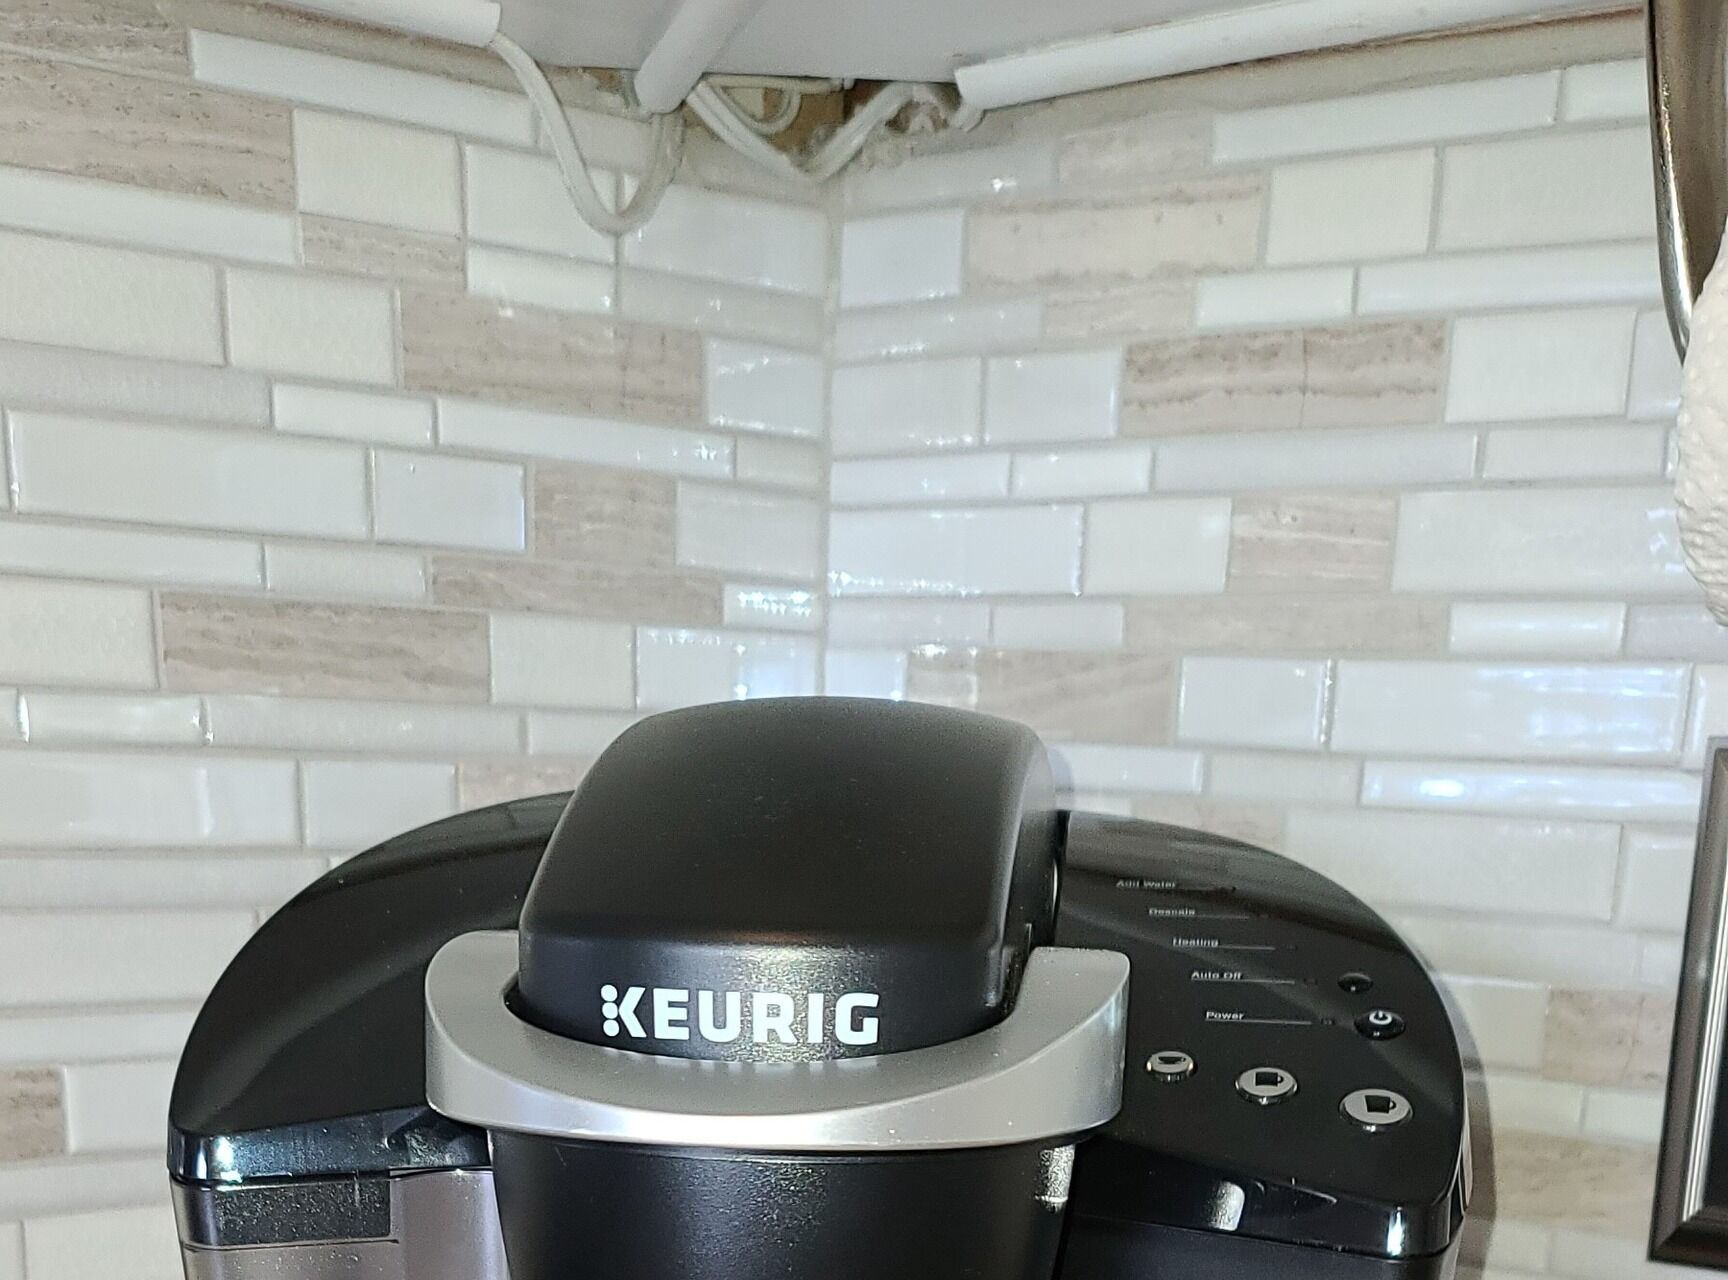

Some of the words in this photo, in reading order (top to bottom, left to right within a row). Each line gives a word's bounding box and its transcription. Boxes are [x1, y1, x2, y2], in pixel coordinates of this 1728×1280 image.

[1172, 937, 1219, 948] Heating
[600, 984, 880, 1046] KEURIG
[1205, 1011, 1245, 1020] Power
